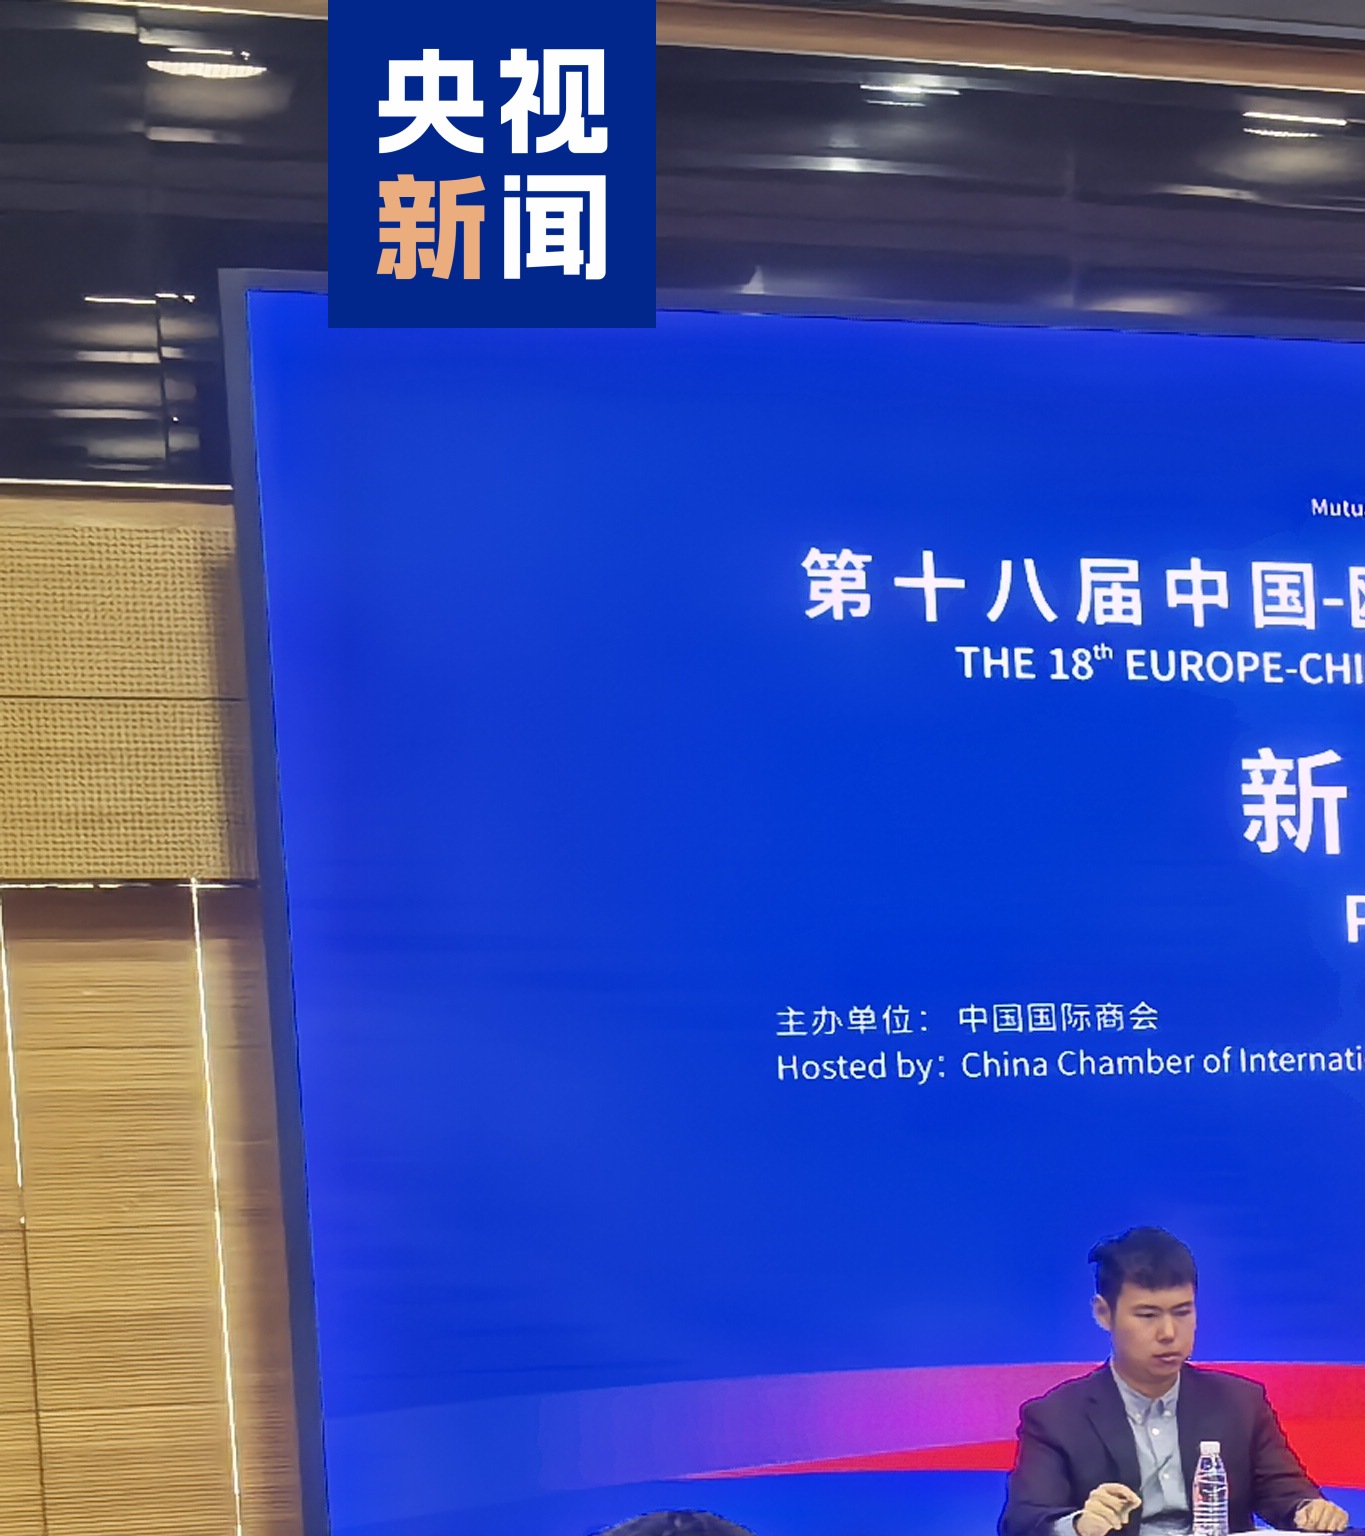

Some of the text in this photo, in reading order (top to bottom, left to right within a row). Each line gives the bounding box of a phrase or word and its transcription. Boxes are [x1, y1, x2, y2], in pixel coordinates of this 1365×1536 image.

[955, 646, 1034, 680] THE
[1048, 643, 1114, 681] 18th
[776, 1001, 1159, 1037] 主办单位： 中国国际商会
[777, 1051, 887, 1080] Hosted
[961, 1050, 1048, 1078] China
[1057, 1048, 1195, 1077] Chamber
[1202, 1046, 1231, 1074] of
